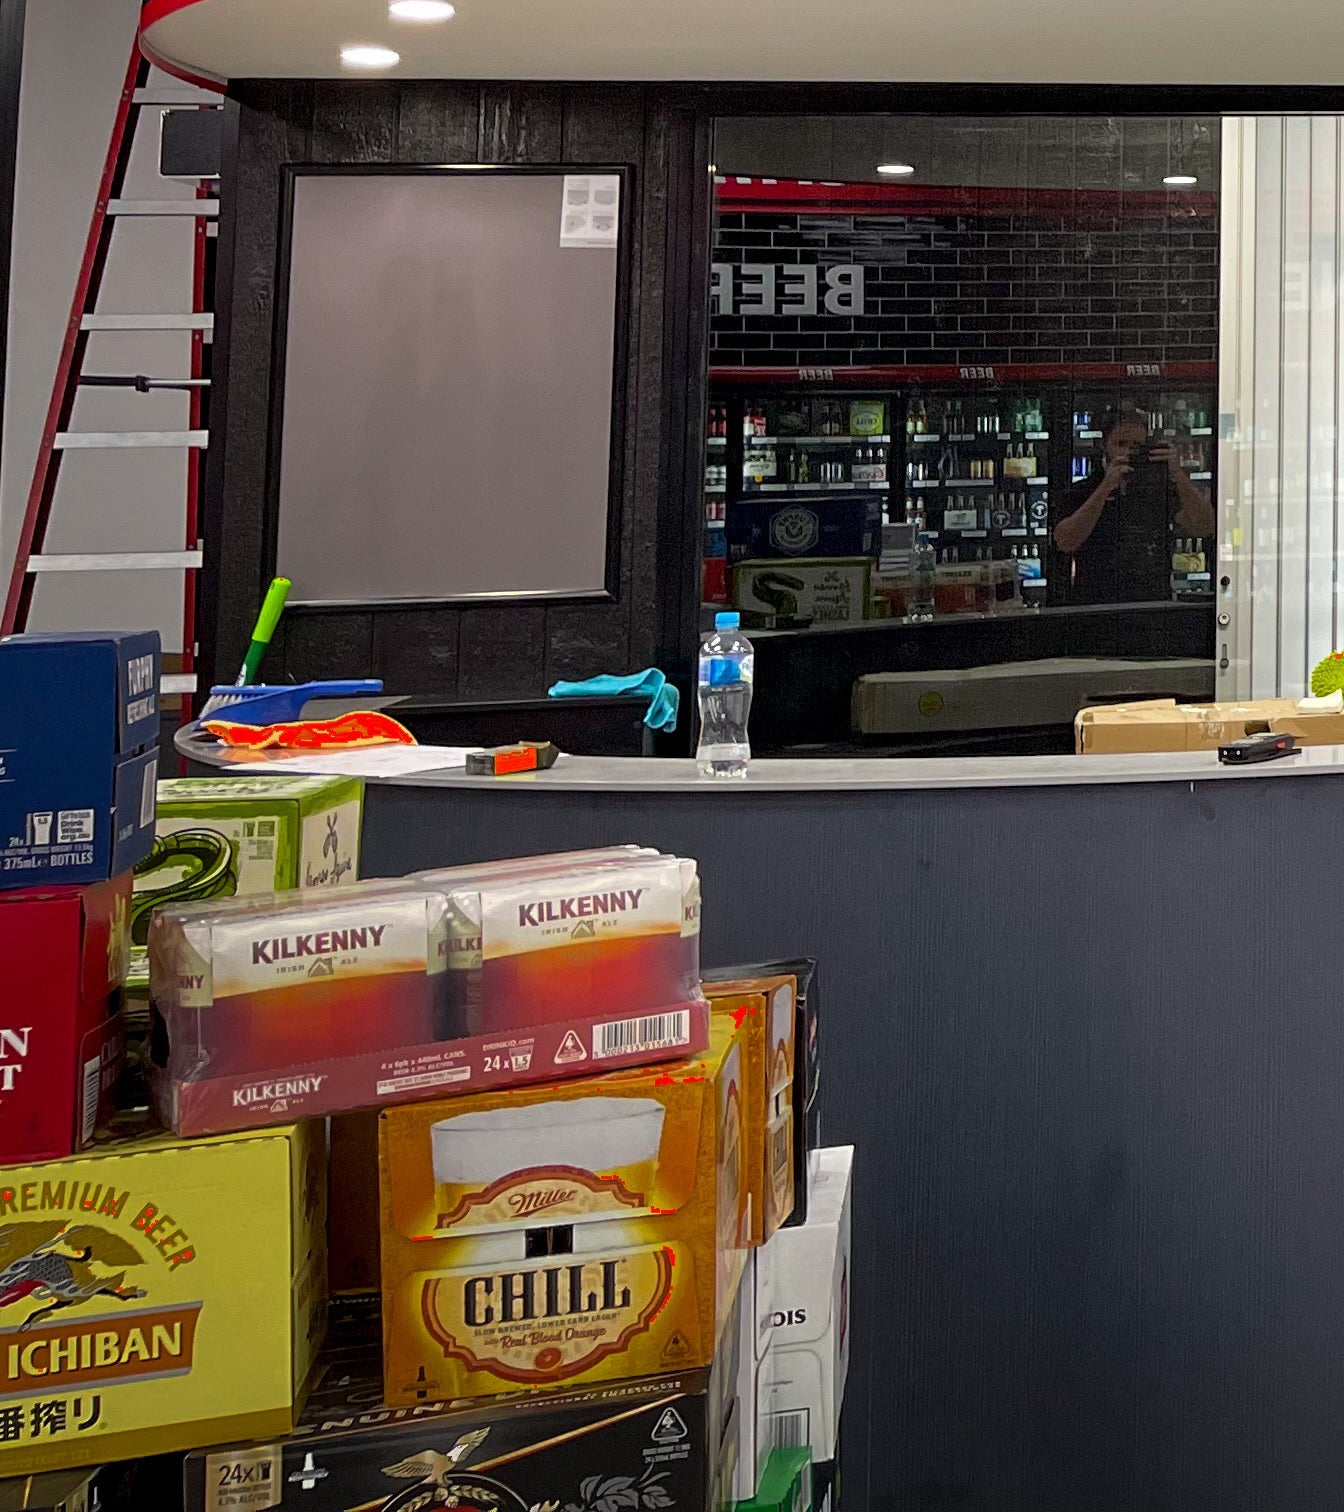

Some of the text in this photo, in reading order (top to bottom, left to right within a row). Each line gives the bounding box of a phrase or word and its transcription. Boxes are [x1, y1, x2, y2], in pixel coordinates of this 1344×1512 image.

[50, 852, 94, 866] BOTTLES
[519, 889, 643, 927] KILKENNY
[251, 925, 386, 965] KILKENNY
[483, 1056, 501, 1072] 24
[503, 1059, 510, 1069] x
[232, 1076, 323, 1107] KILKENNY
[508, 1188, 579, 1218] Miller
[130, 1202, 197, 1272] BEER
[463, 1259, 631, 1328] CHILL
[8, 1322, 182, 1380] ICHIBAN
[500, 1335, 527, 1349] Real
[528, 1330, 563, 1346] Blood
[565, 1327, 608, 1342] Orange
